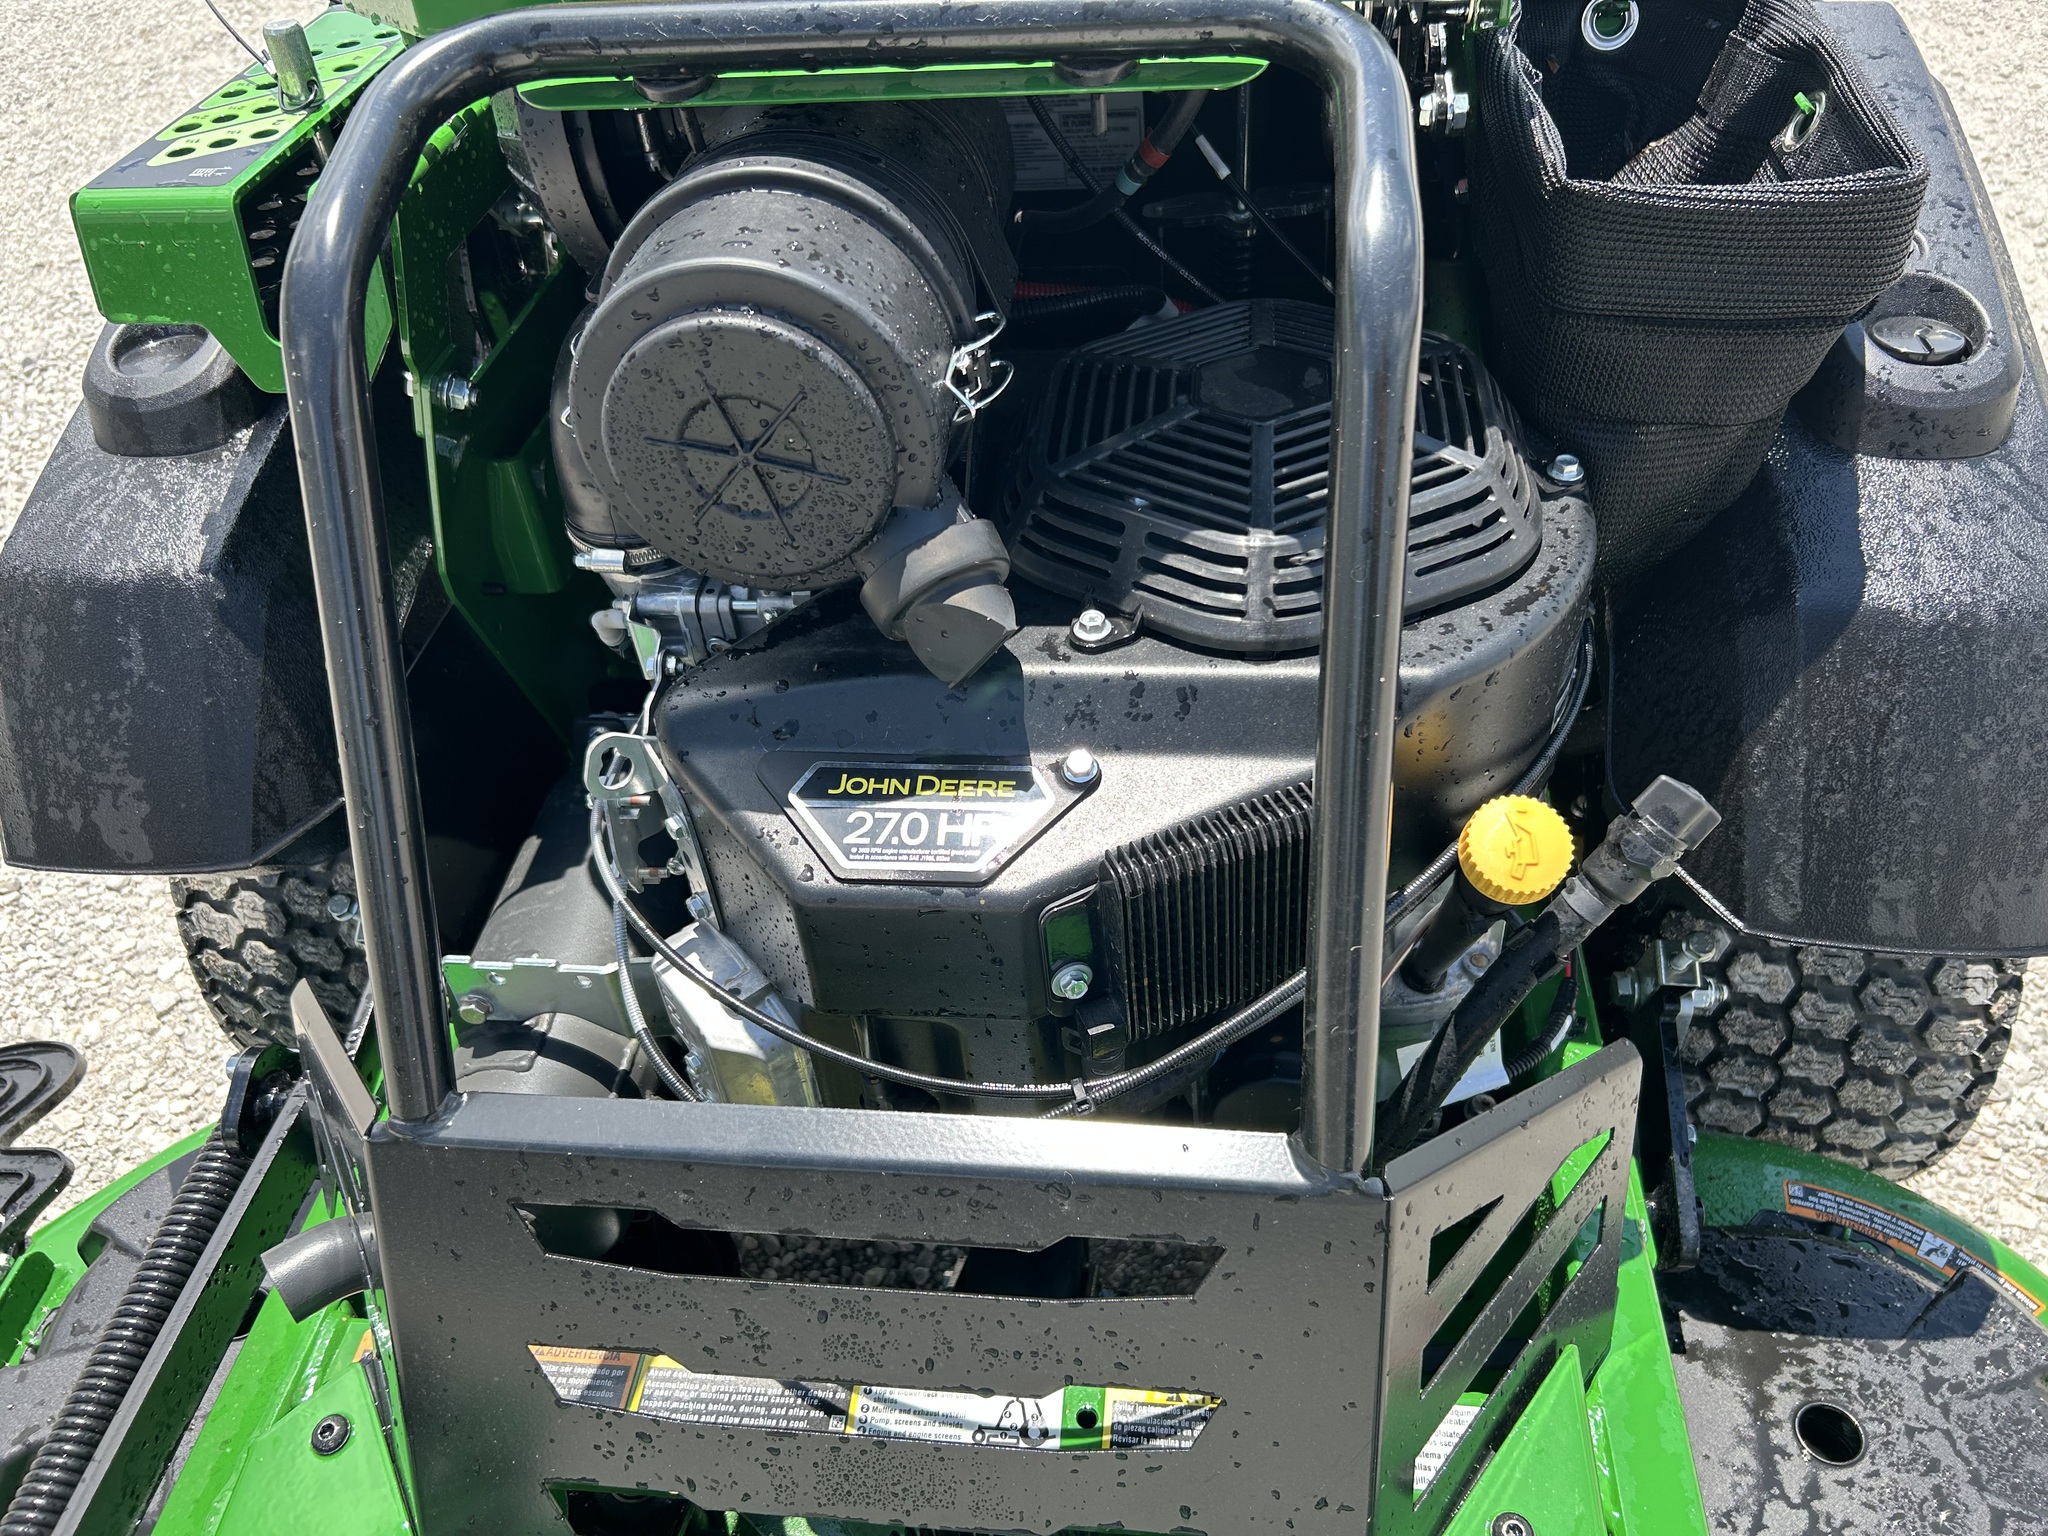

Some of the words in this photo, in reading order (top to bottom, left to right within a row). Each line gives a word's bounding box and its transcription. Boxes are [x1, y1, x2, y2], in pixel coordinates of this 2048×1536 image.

[828, 773, 911, 795] JOHN
[915, 775, 1017, 798] DEERE
[843, 811, 929, 846] 27.0
[546, 1347, 621, 1361] ADVERTENCIA
[560, 1364, 573, 1374] ser
[574, 1365, 610, 1376] lesionado
[611, 1368, 625, 1378] por
[647, 1367, 672, 1378] Avoid
[557, 1377, 567, 1385] en
[568, 1376, 614, 1388] movimiento,
[570, 1387, 582, 1397] los
[583, 1389, 614, 1398] escudos
[643, 1388, 653, 1396] or
[653, 1389, 672, 1397] near
[689, 1390, 699, 1398] or
[700, 1391, 730, 1402] moving
[730, 1392, 752, 1402] parts
[803, 1396, 822, 1405] fire.
[646, 1380, 699, 1391] Accumulation
[701, 1383, 711, 1392] of
[738, 1384, 766, 1394] leaves
[767, 1386, 783, 1396] and
[784, 1387, 806, 1397] other
[807, 1388, 834, 1399] debris
[835, 1391, 846, 1399] on
[873, 1396, 898, 1405] shields
[640, 1399, 671, 1409] Inspect
[671, 1400, 709, 1411] machine
[707, 1402, 737, 1413] before,
[738, 1404, 769, 1415] during,
[770, 1406, 787, 1415] and
[788, 1406, 809, 1417] after
[809, 1409, 828, 1418] use.
[871, 1405, 897, 1415] Muffler
[898, 1407, 912, 1416] and
[912, 1408, 940, 1418] exhaust
[941, 1411, 967, 1419] system
[671, 1412, 699, 1422] engine
[699, 1413, 717, 1422] and
[718, 1414, 741, 1424] allow
[741, 1416, 777, 1426] machine
[778, 1417, 788, 1427] to
[788, 1418, 811, 1428] cool.
[869, 1416, 892, 1426] Pump,
[894, 1418, 921, 1426] screens
[923, 1419, 937, 1427] and
[938, 1420, 964, 1429] shields
[1181, 1419, 1190, 1427] de
[868, 1427, 892, 1436] Engine
[893, 1429, 907, 1438] and
[908, 1431, 932, 1439] engine
[934, 1432, 962, 1441] screens
[1113, 1422, 1122, 1430] de
[1123, 1424, 1146, 1434] piezas
[1147, 1425, 1175, 1435] caliente
[1182, 1428, 1191, 1436] en
[1112, 1434, 1139, 1444] Revisar
[1140, 1435, 1147, 1445] la
